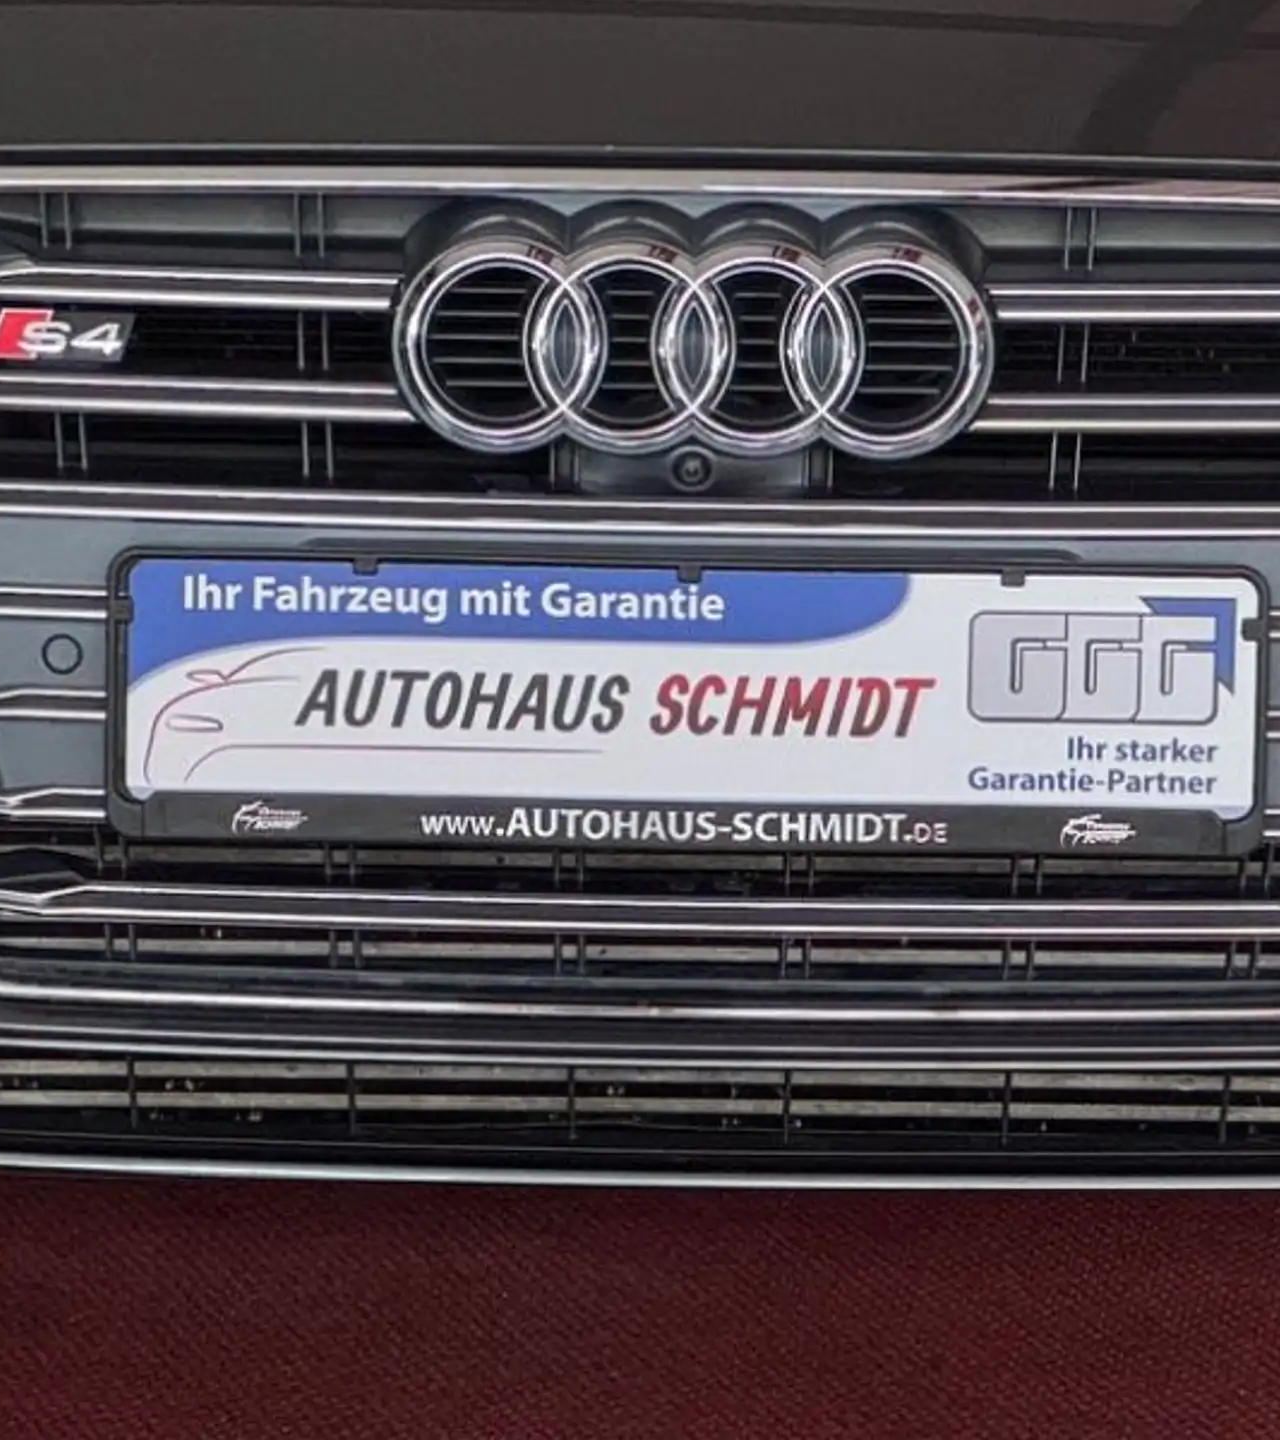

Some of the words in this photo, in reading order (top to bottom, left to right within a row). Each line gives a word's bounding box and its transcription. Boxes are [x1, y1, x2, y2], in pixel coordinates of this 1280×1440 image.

[17, 320, 123, 357] S4
[183, 575, 242, 611] Ihr
[253, 576, 448, 623] Fahrzeug
[461, 581, 530, 617] mit
[542, 583, 725, 621] Garantie
[295, 669, 631, 734] AUTOHAUS
[649, 673, 936, 738] SCHMIDT
[1066, 736, 1107, 761] Ihr
[1115, 738, 1218, 763] starker
[968, 766, 1218, 794] Garantie-Partner
[421, 807, 949, 844] www.AUTOHAUS-SCHMIDT.DE
